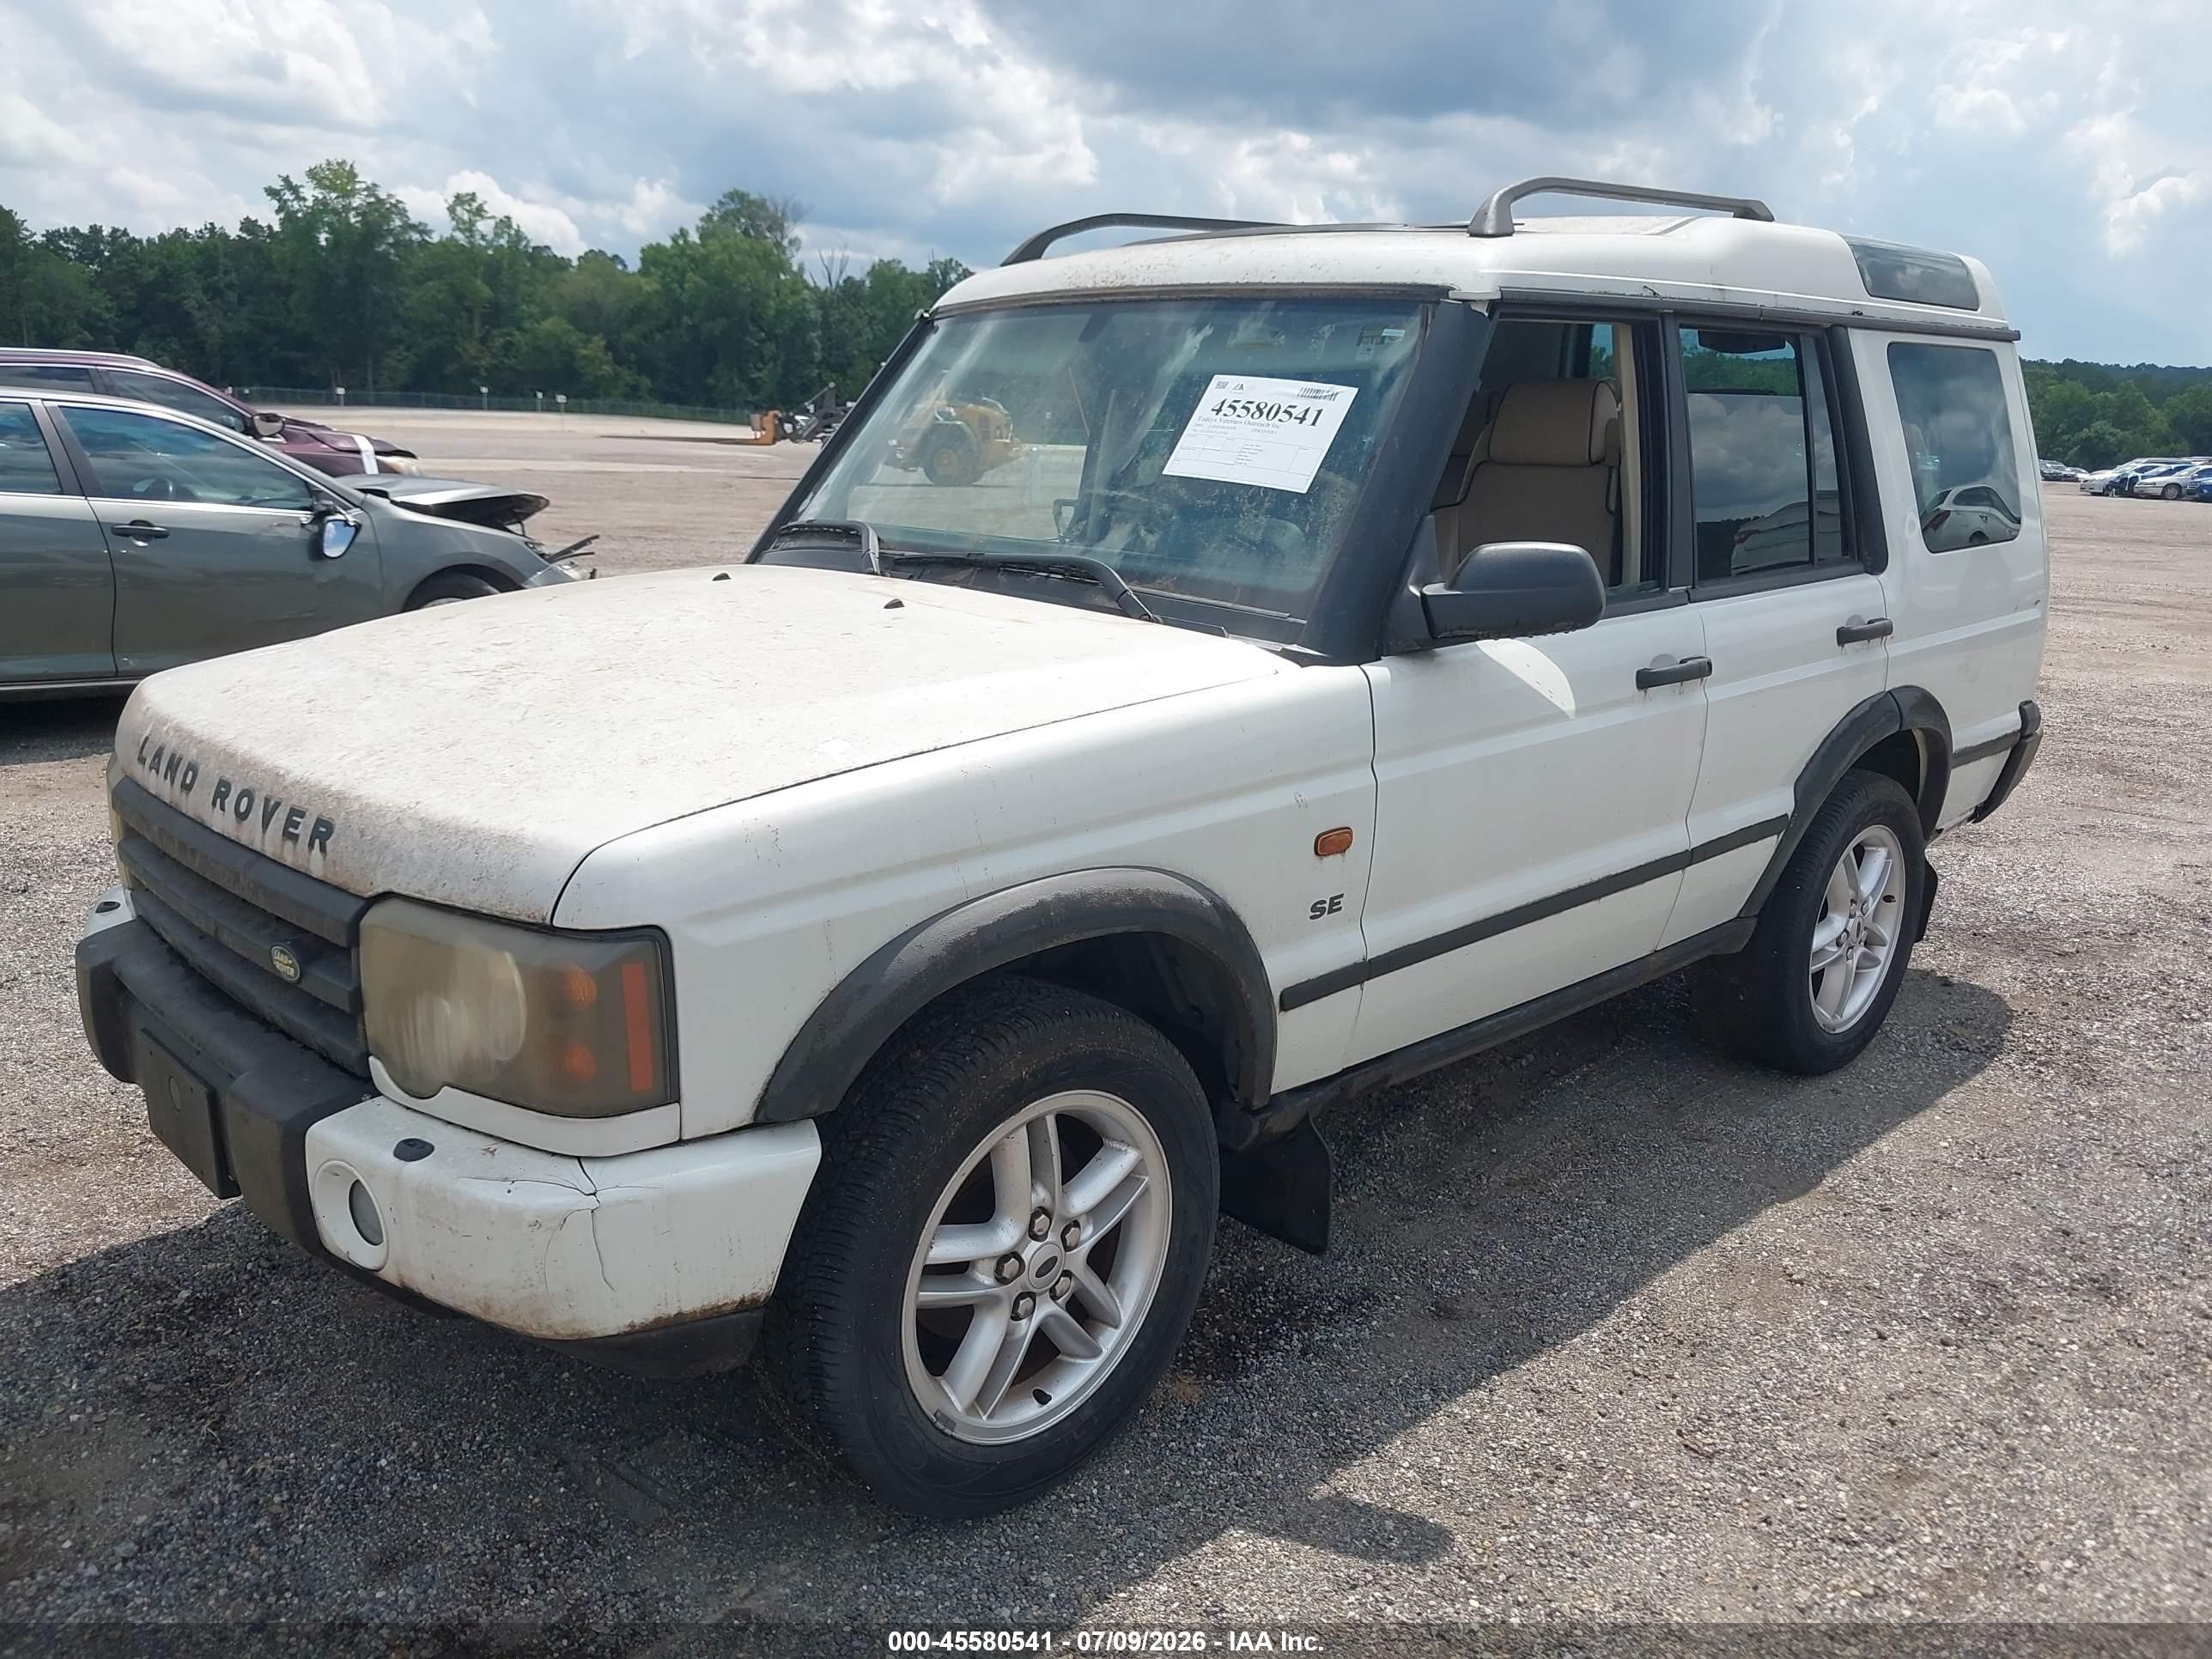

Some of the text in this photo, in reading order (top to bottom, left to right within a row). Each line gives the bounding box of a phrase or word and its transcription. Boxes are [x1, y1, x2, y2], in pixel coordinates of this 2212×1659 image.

[1211, 398, 1324, 427] 45580541
[137, 736, 335, 853] LAND ROVER
[1309, 893, 1345, 921] SE
